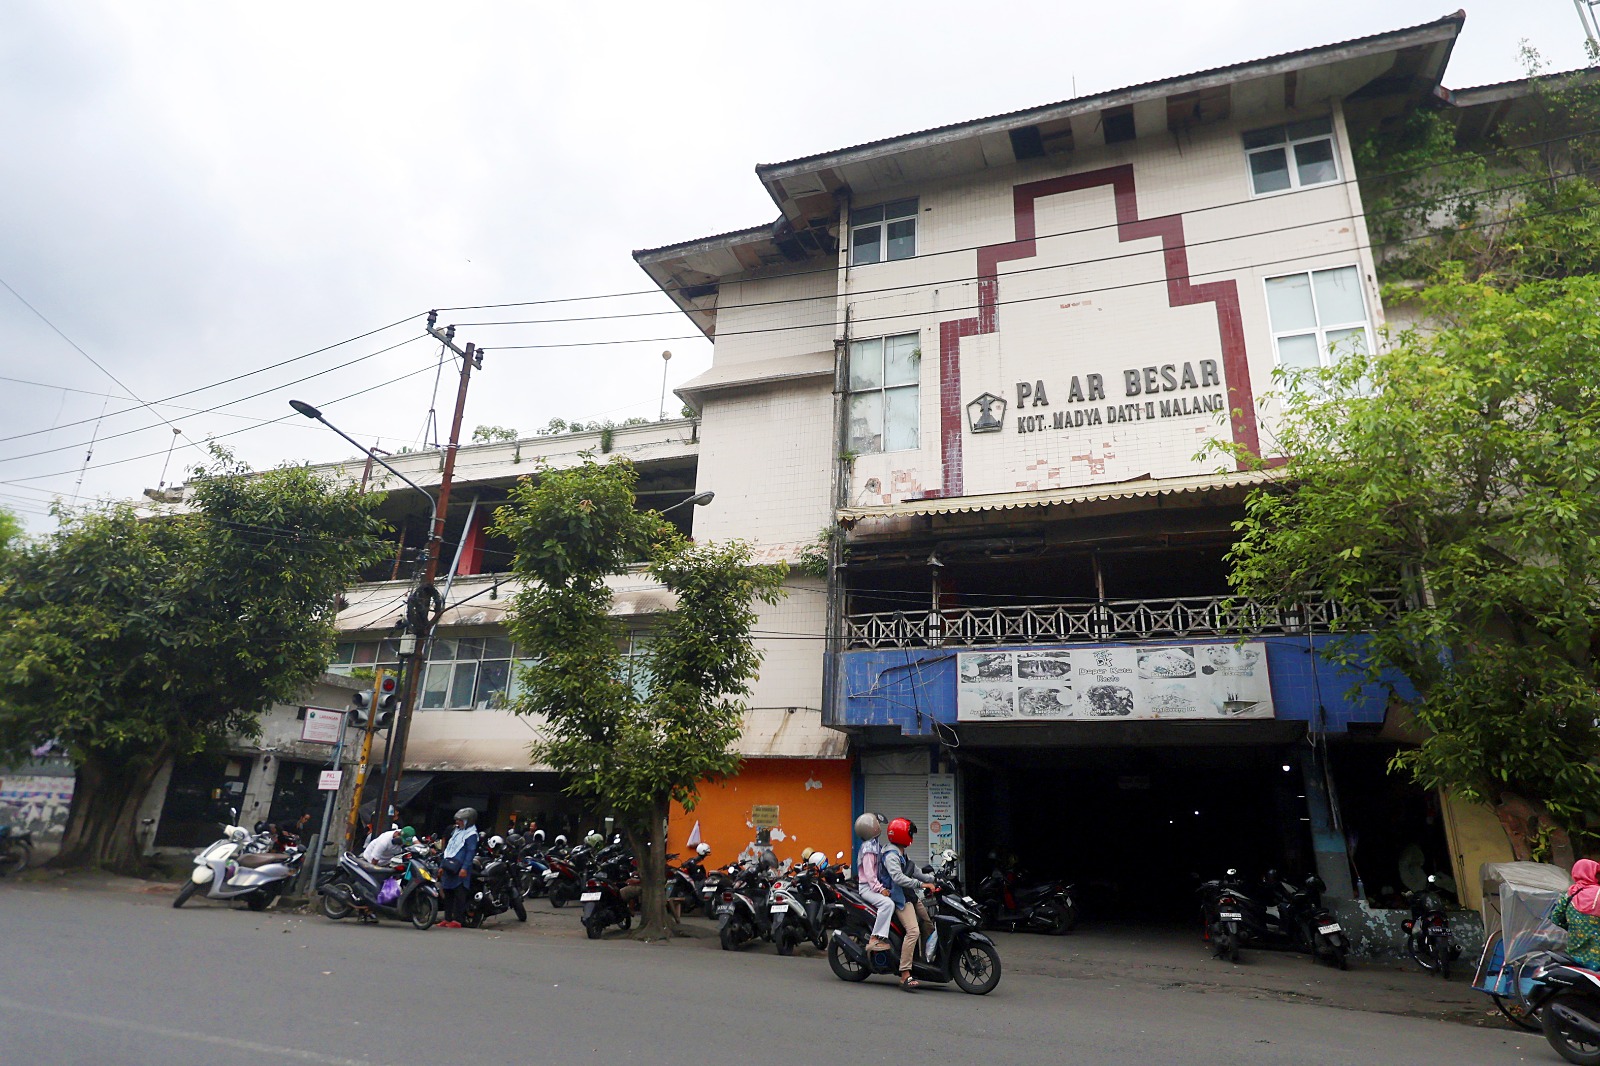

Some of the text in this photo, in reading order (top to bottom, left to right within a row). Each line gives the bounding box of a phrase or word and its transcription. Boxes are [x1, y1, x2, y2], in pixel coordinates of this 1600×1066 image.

[1123, 358, 1220, 397] BESAR
[1159, 393, 1224, 418] MALANG
[1079, 668, 1107, 676] Dapur
